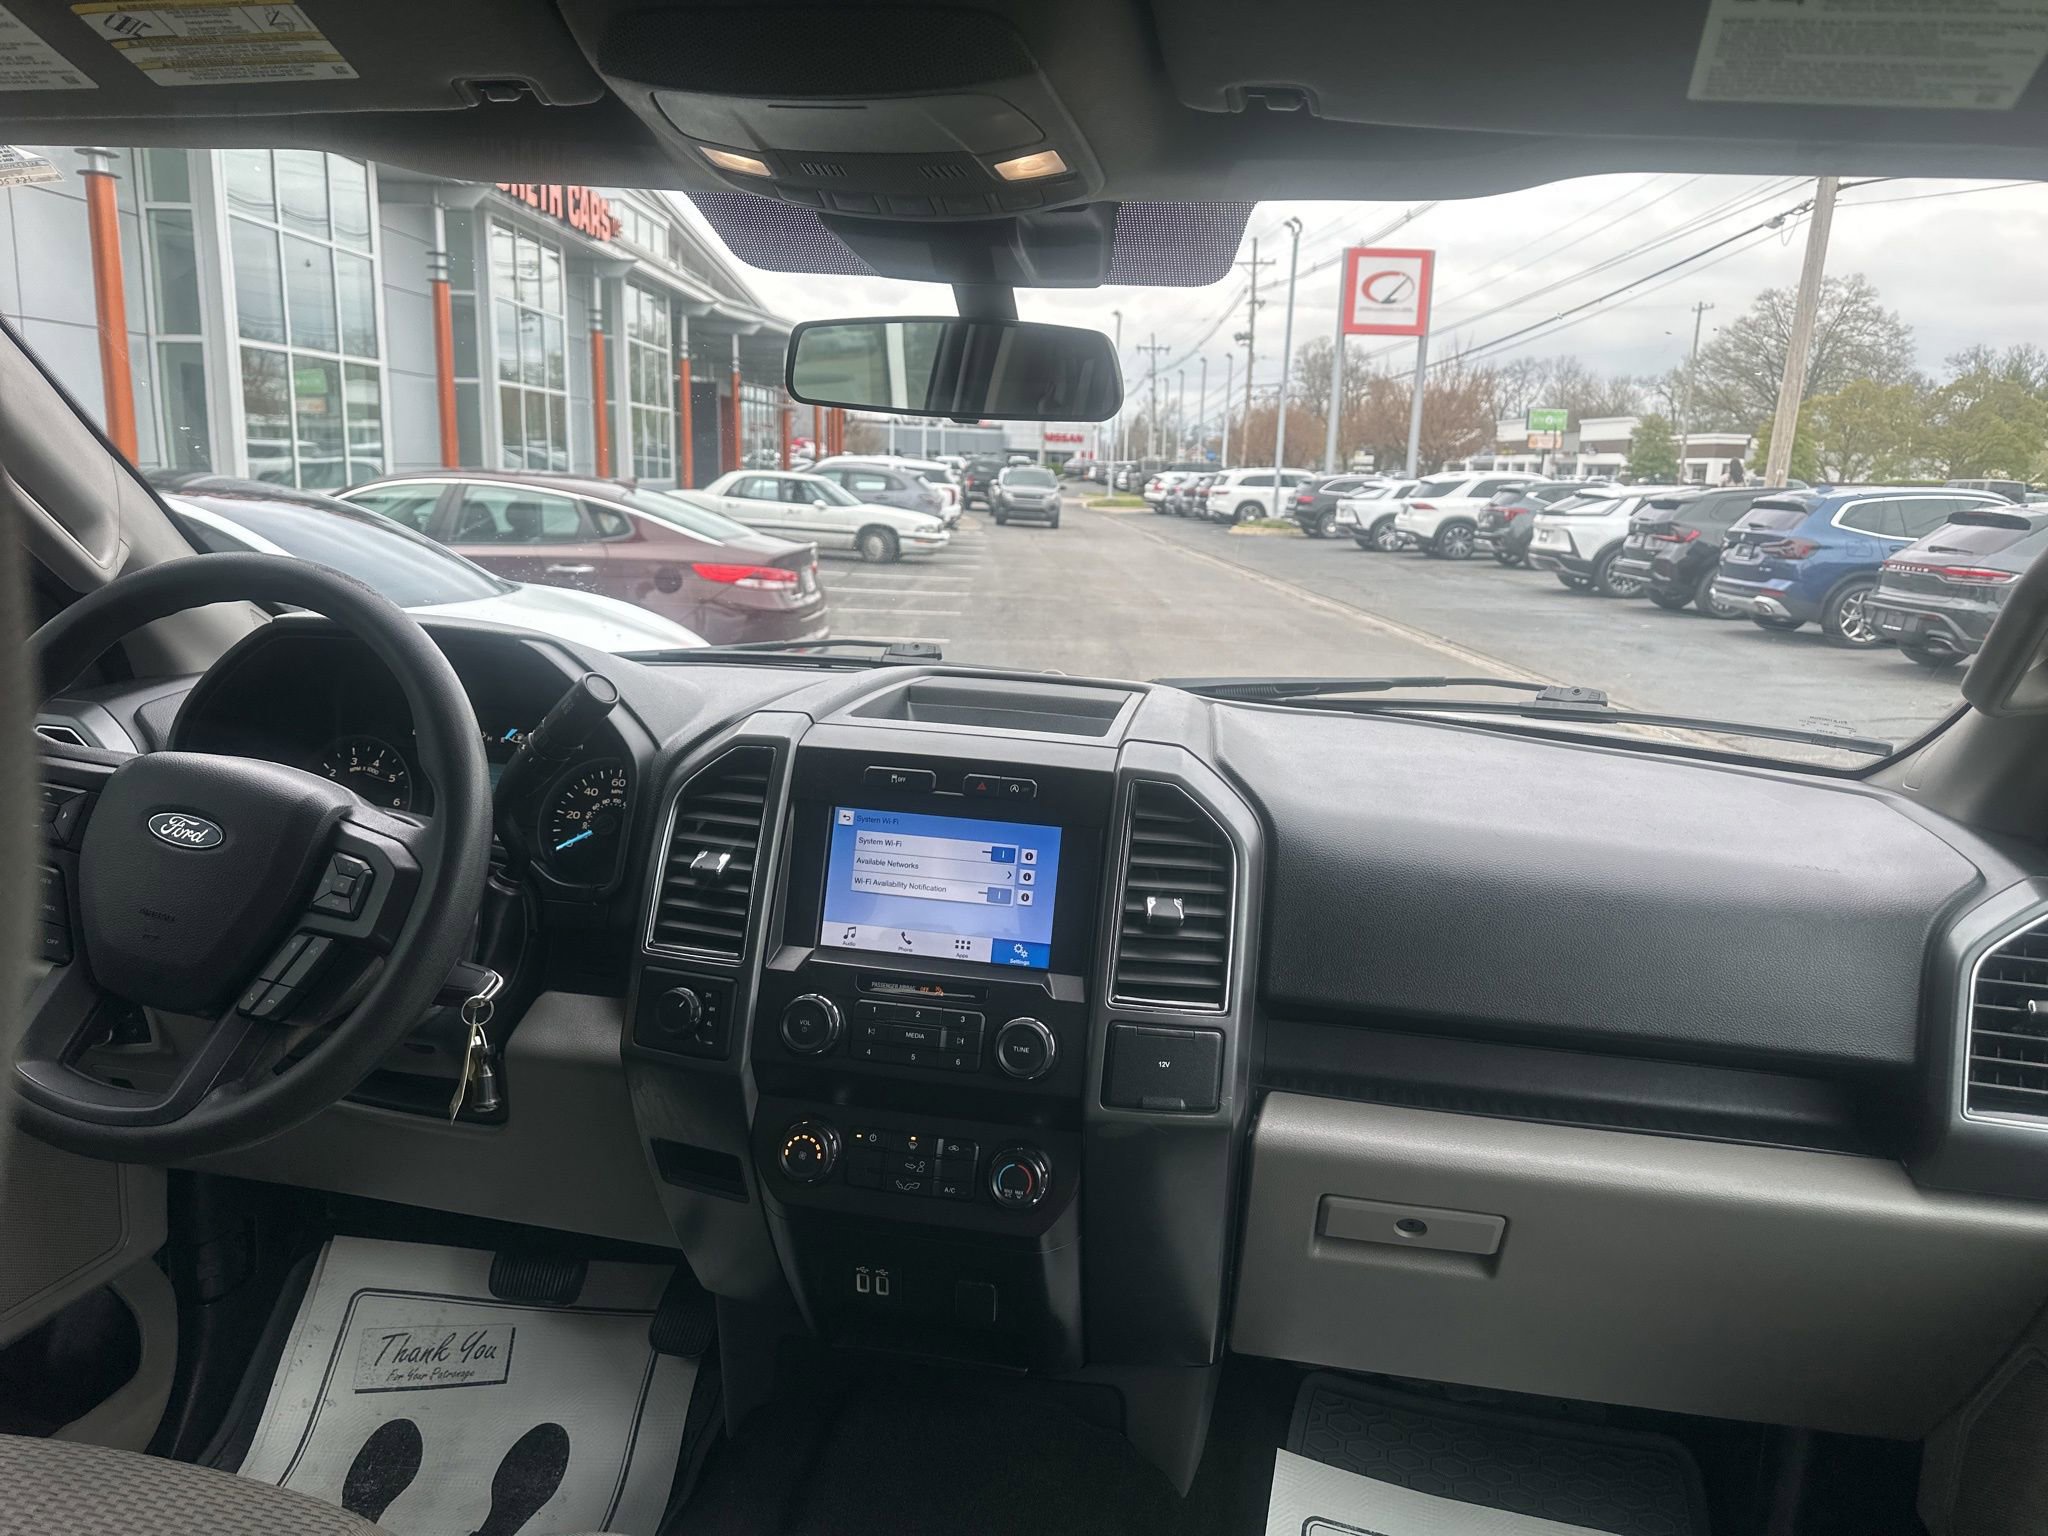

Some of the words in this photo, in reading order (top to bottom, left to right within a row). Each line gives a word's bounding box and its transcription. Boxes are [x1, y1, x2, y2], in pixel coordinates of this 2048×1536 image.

[567, 185, 611, 242] CARS
[351, 757, 358, 766] 3
[372, 759, 380, 767] 4
[329, 768, 337, 777] 2
[388, 774, 396, 783] 5
[611, 778, 626, 787] 60
[583, 787, 599, 797] 40
[393, 798, 400, 806] 6
[566, 810, 581, 820] 20
[857, 815, 881, 824] System
[882, 817, 900, 825] Wi-Fi
[161, 816, 209, 843] Ford
[858, 837, 884, 846] System
[885, 839, 902, 847] Wi-Fi
[856, 858, 886, 867] Available
[887, 861, 919, 870] Networks
[854, 878, 872, 886] Wi-Fi
[873, 880, 908, 890] Availability
[909, 883, 947, 892] Notification
[871, 981, 898, 990] PASSENGER
[915, 1010, 921, 1018] 2
[960, 1015, 966, 1023] 3
[905, 1032, 925, 1040] MEDIA
[866, 1048, 872, 1056] 4
[1013, 1045, 1030, 1054] TUNE
[910, 1052, 916, 1060] 5
[955, 1058, 962, 1066] 6
[944, 1186, 956, 1194] A/C
[374, 1332, 457, 1367] Thank
[460, 1329, 497, 1363] You
[386, 1368, 404, 1382] For
[407, 1367, 428, 1382] Your
[431, 1367, 476, 1382] Patronage
